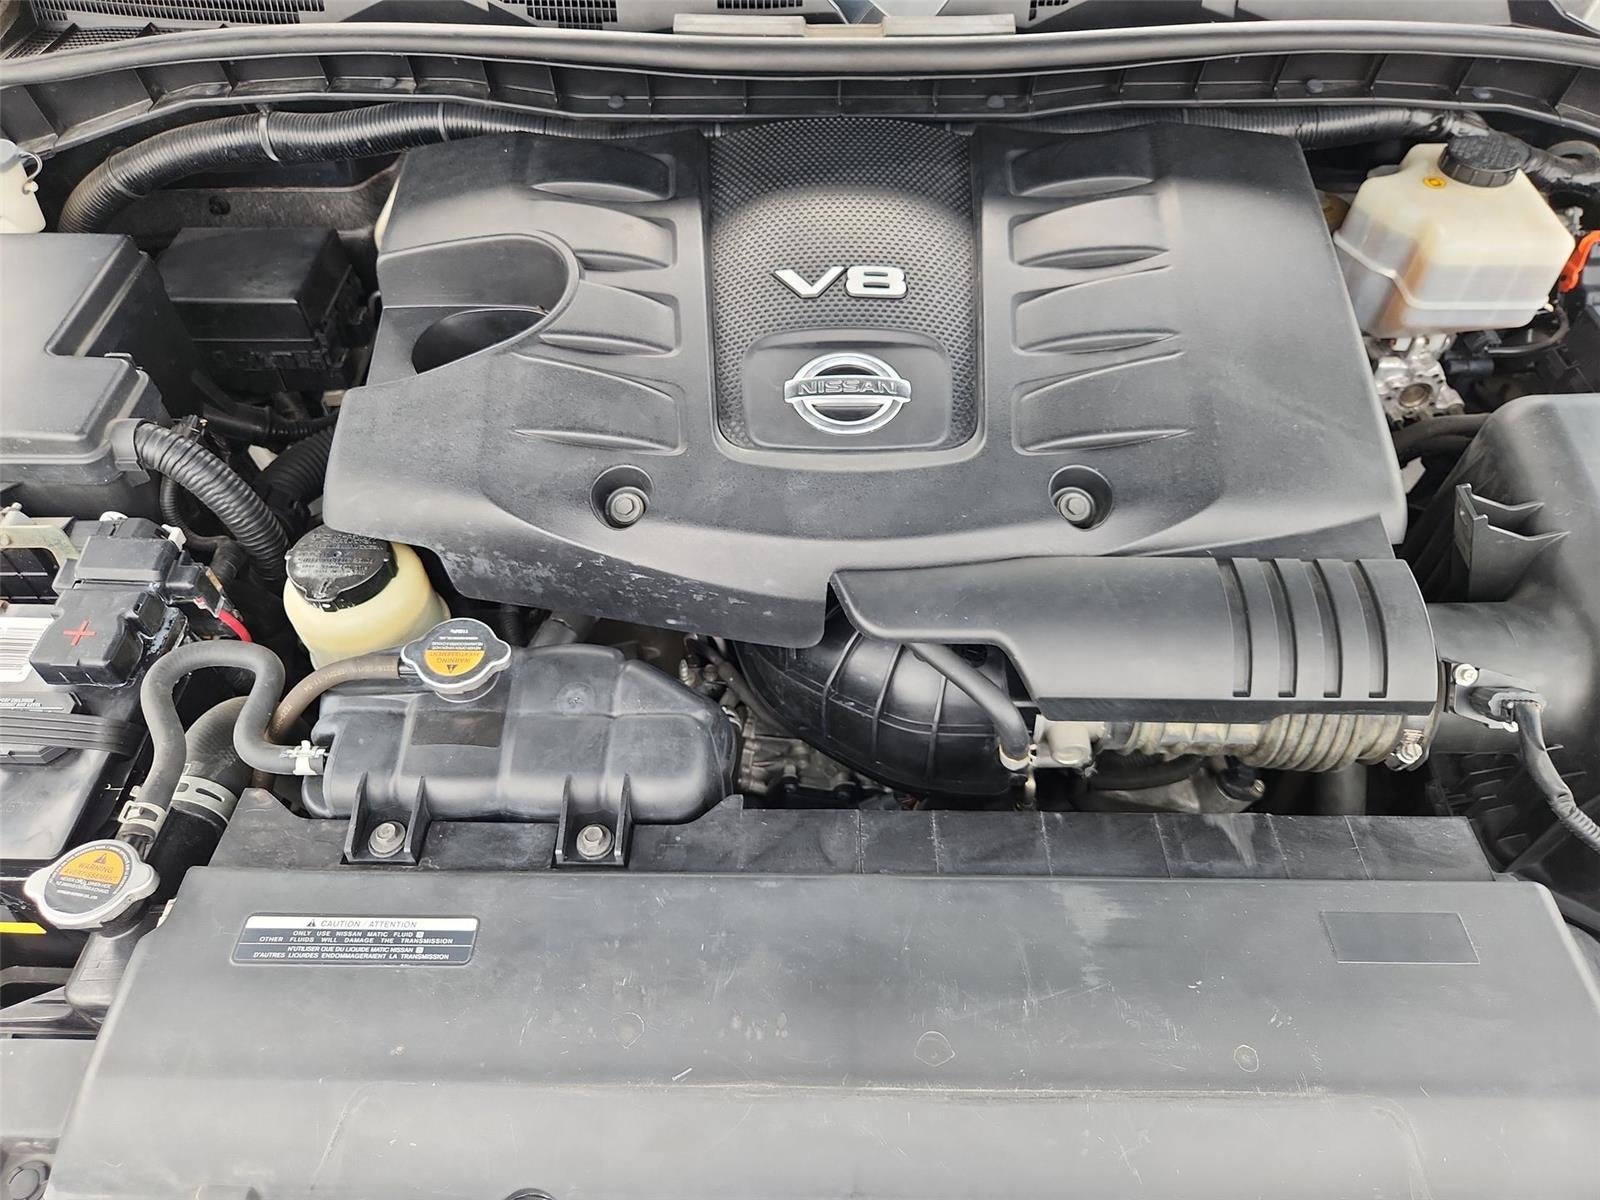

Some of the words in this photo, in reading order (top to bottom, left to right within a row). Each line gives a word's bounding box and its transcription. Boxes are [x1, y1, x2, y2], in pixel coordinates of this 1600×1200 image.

[772, 266, 908, 299] V8
[798, 379, 898, 395] NISSAN
[78, 863, 114, 874] WARNING
[320, 920, 360, 928] CAUTION
[368, 920, 417, 929] ATTENTION
